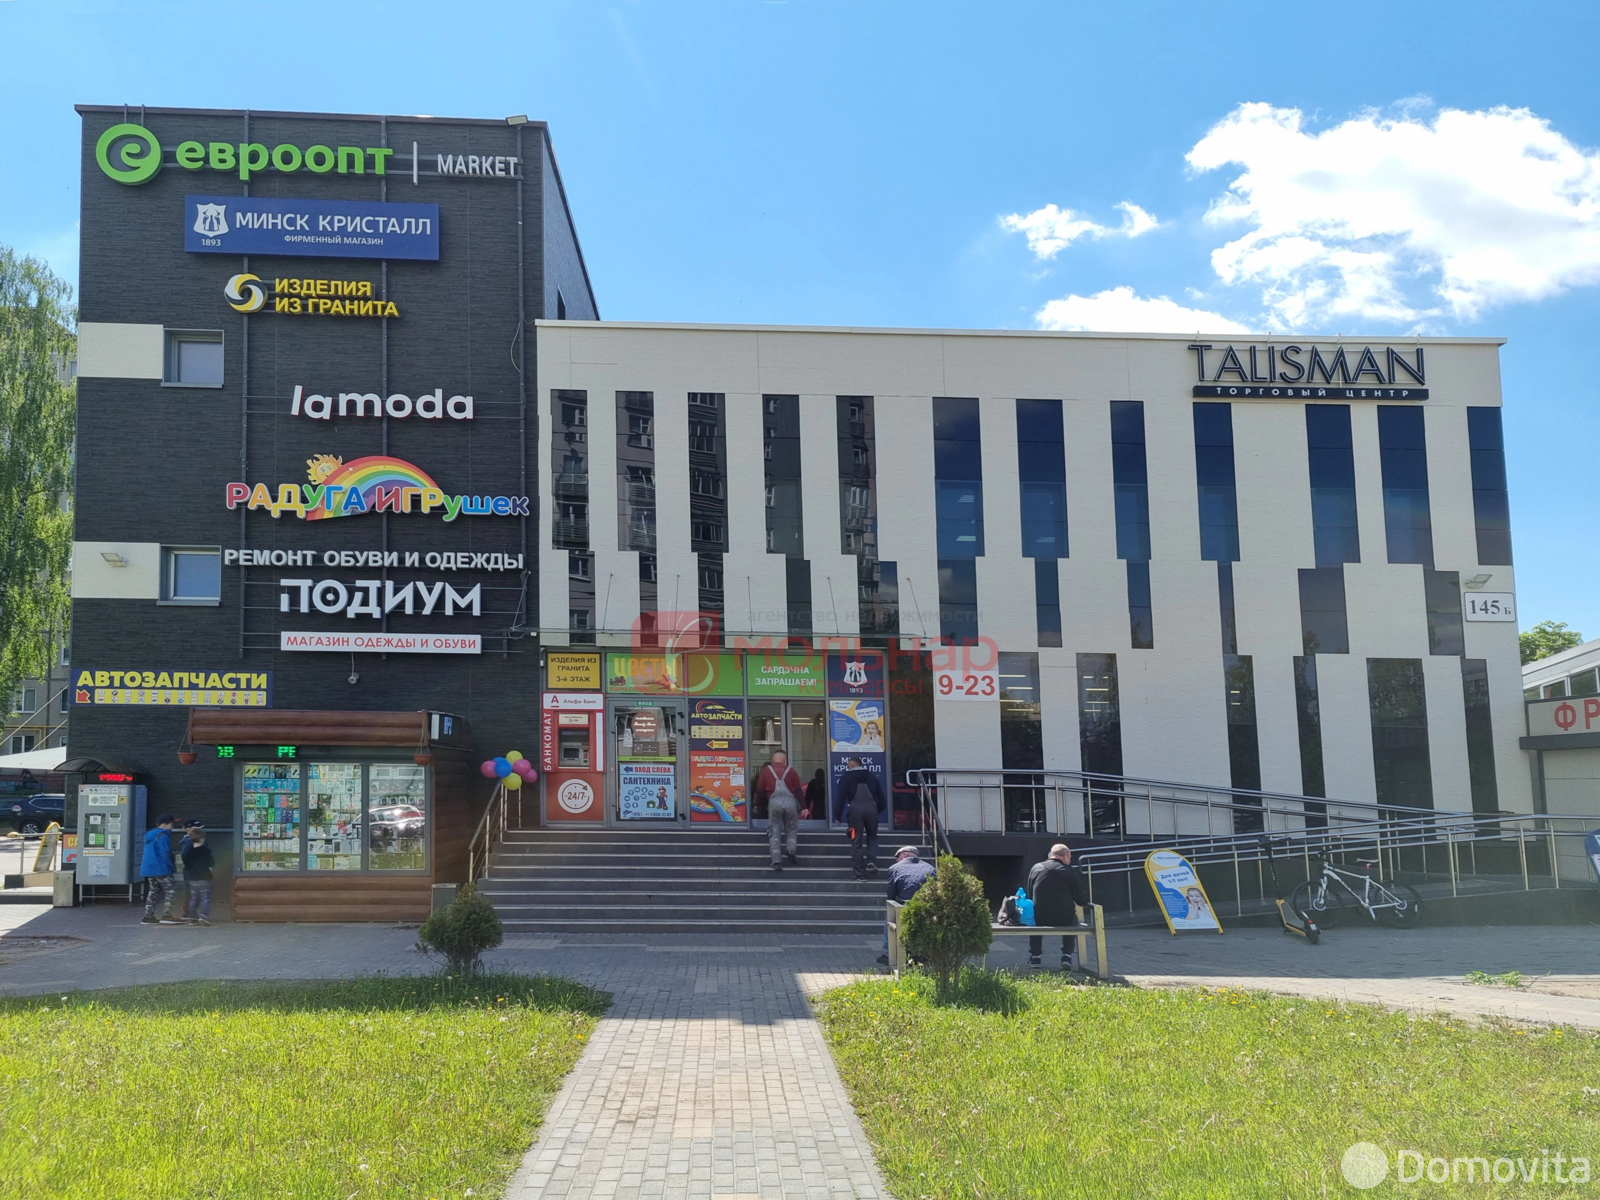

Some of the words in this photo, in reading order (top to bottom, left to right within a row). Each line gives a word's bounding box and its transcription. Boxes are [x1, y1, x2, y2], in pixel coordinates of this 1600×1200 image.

[176, 140, 394, 181] евроопт
[437, 153, 518, 178] MARKET
[236, 212, 310, 231] МИНСК
[318, 214, 431, 235] КРИСТАЛЛ
[284, 234, 342, 244] ФИРМЕННЫЙ
[344, 236, 384, 246] МАГАЗИН
[275, 278, 372, 297] ИЗДЕЛИЯ
[275, 298, 302, 313] ИЗ
[308, 298, 399, 318] ГРАНИТА
[1188, 344, 1426, 386] TALISMAN
[290, 385, 474, 420] lamoda
[1216, 387, 1326, 397] ТОРГОВЫЙ
[1346, 389, 1409, 398] ЦЕНТР
[226, 482, 367, 519] РАДУГА
[375, 486, 530, 522] ИГРушек
[224, 550, 317, 566] РЕМОНТ
[324, 551, 398, 568] ОБУВИ
[405, 552, 420, 568] И
[426, 552, 524, 572] ОДЕЖДЫ
[280, 578, 481, 619] ПОДИУМ
[286, 636, 350, 647] МАГАЗИН
[354, 637, 416, 649] ОДЕЖДЫ
[420, 638, 429, 648] И
[433, 638, 476, 649] ОБУВИ
[614, 657, 678, 680] ЦВЕТЫ
[761, 666, 810, 676] САРДЭЧНА
[76, 670, 267, 689] АВТОЗАПЧАСТИ
[755, 677, 817, 686] ЗАПРАШАЕМ!
[938, 674, 996, 696] 9-23
[623, 777, 671, 786] САНТЕХНИКА
